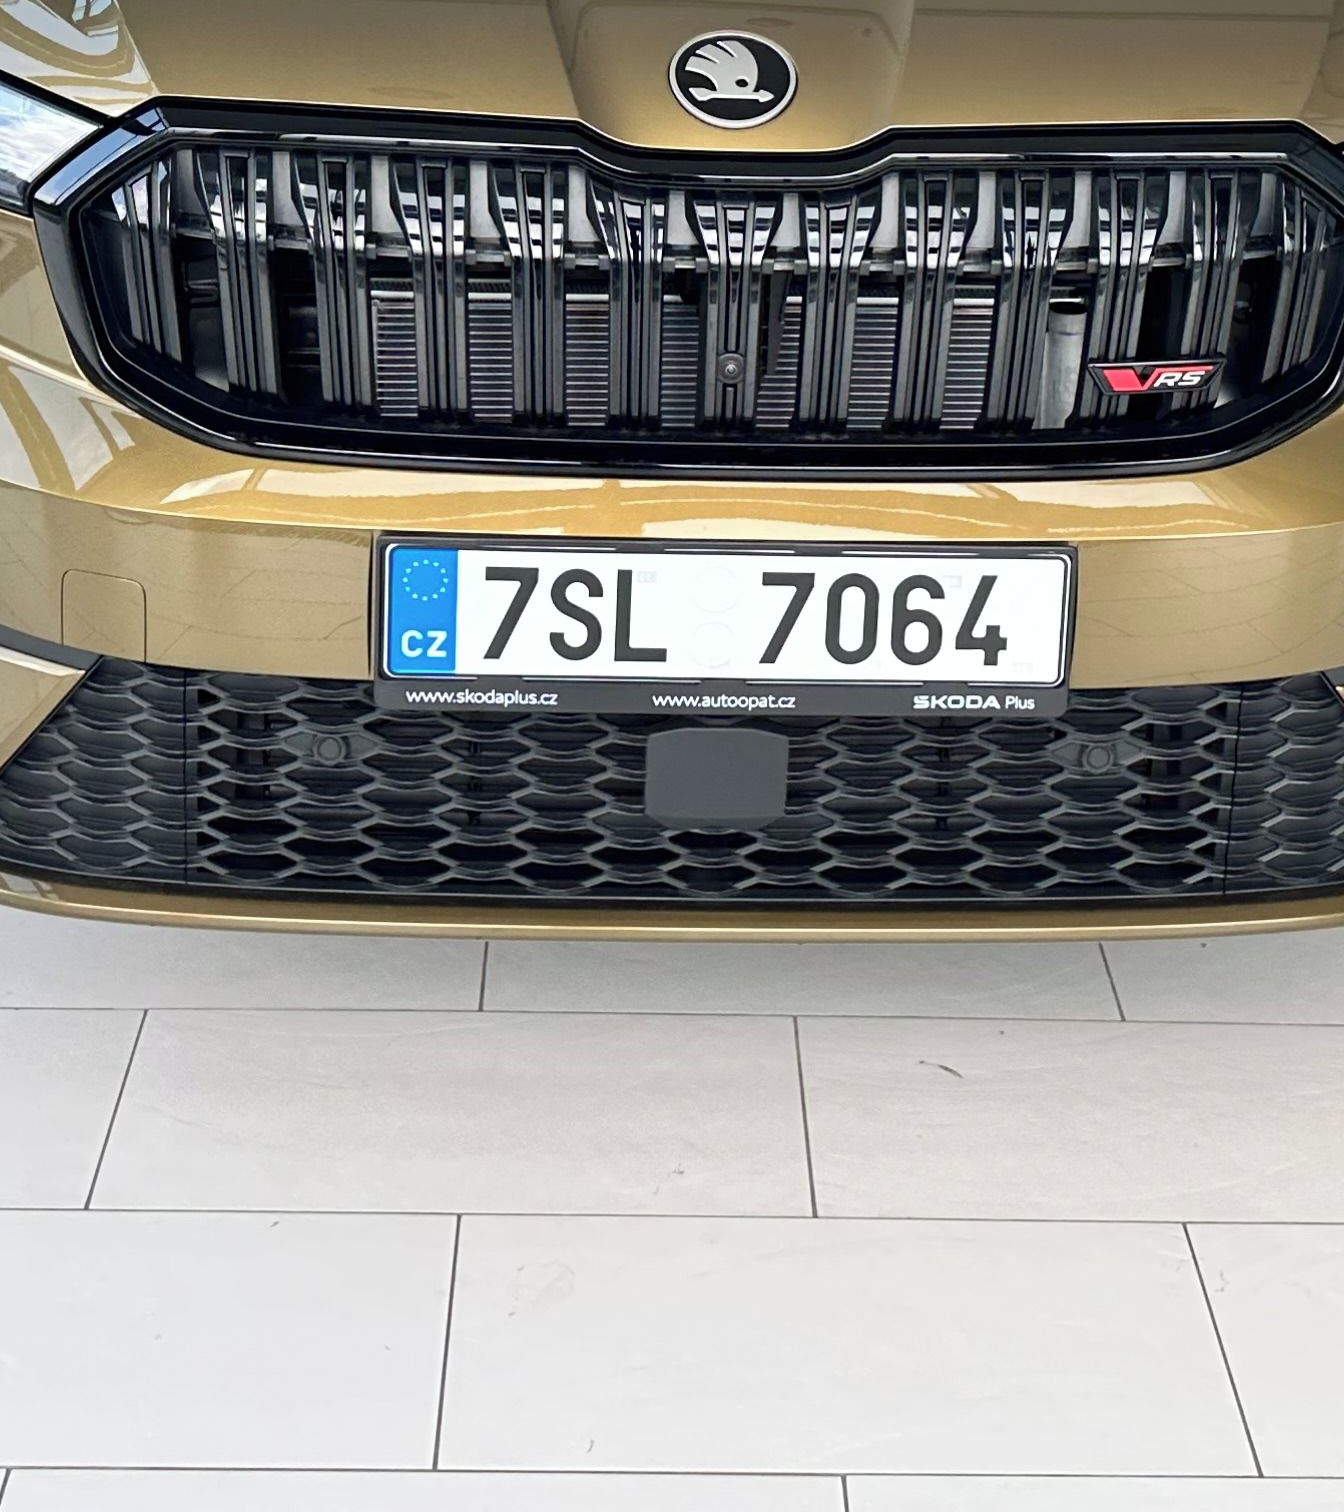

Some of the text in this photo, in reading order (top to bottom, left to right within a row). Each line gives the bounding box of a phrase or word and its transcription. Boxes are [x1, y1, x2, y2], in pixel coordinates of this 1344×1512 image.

[482, 566, 1008, 666] 7SL 7064
[400, 630, 448, 659] CZ
[405, 688, 559, 707] www.skodaplus.cz
[652, 693, 797, 711] www.autoopat.cz
[912, 694, 1036, 711] SKODA Plus
